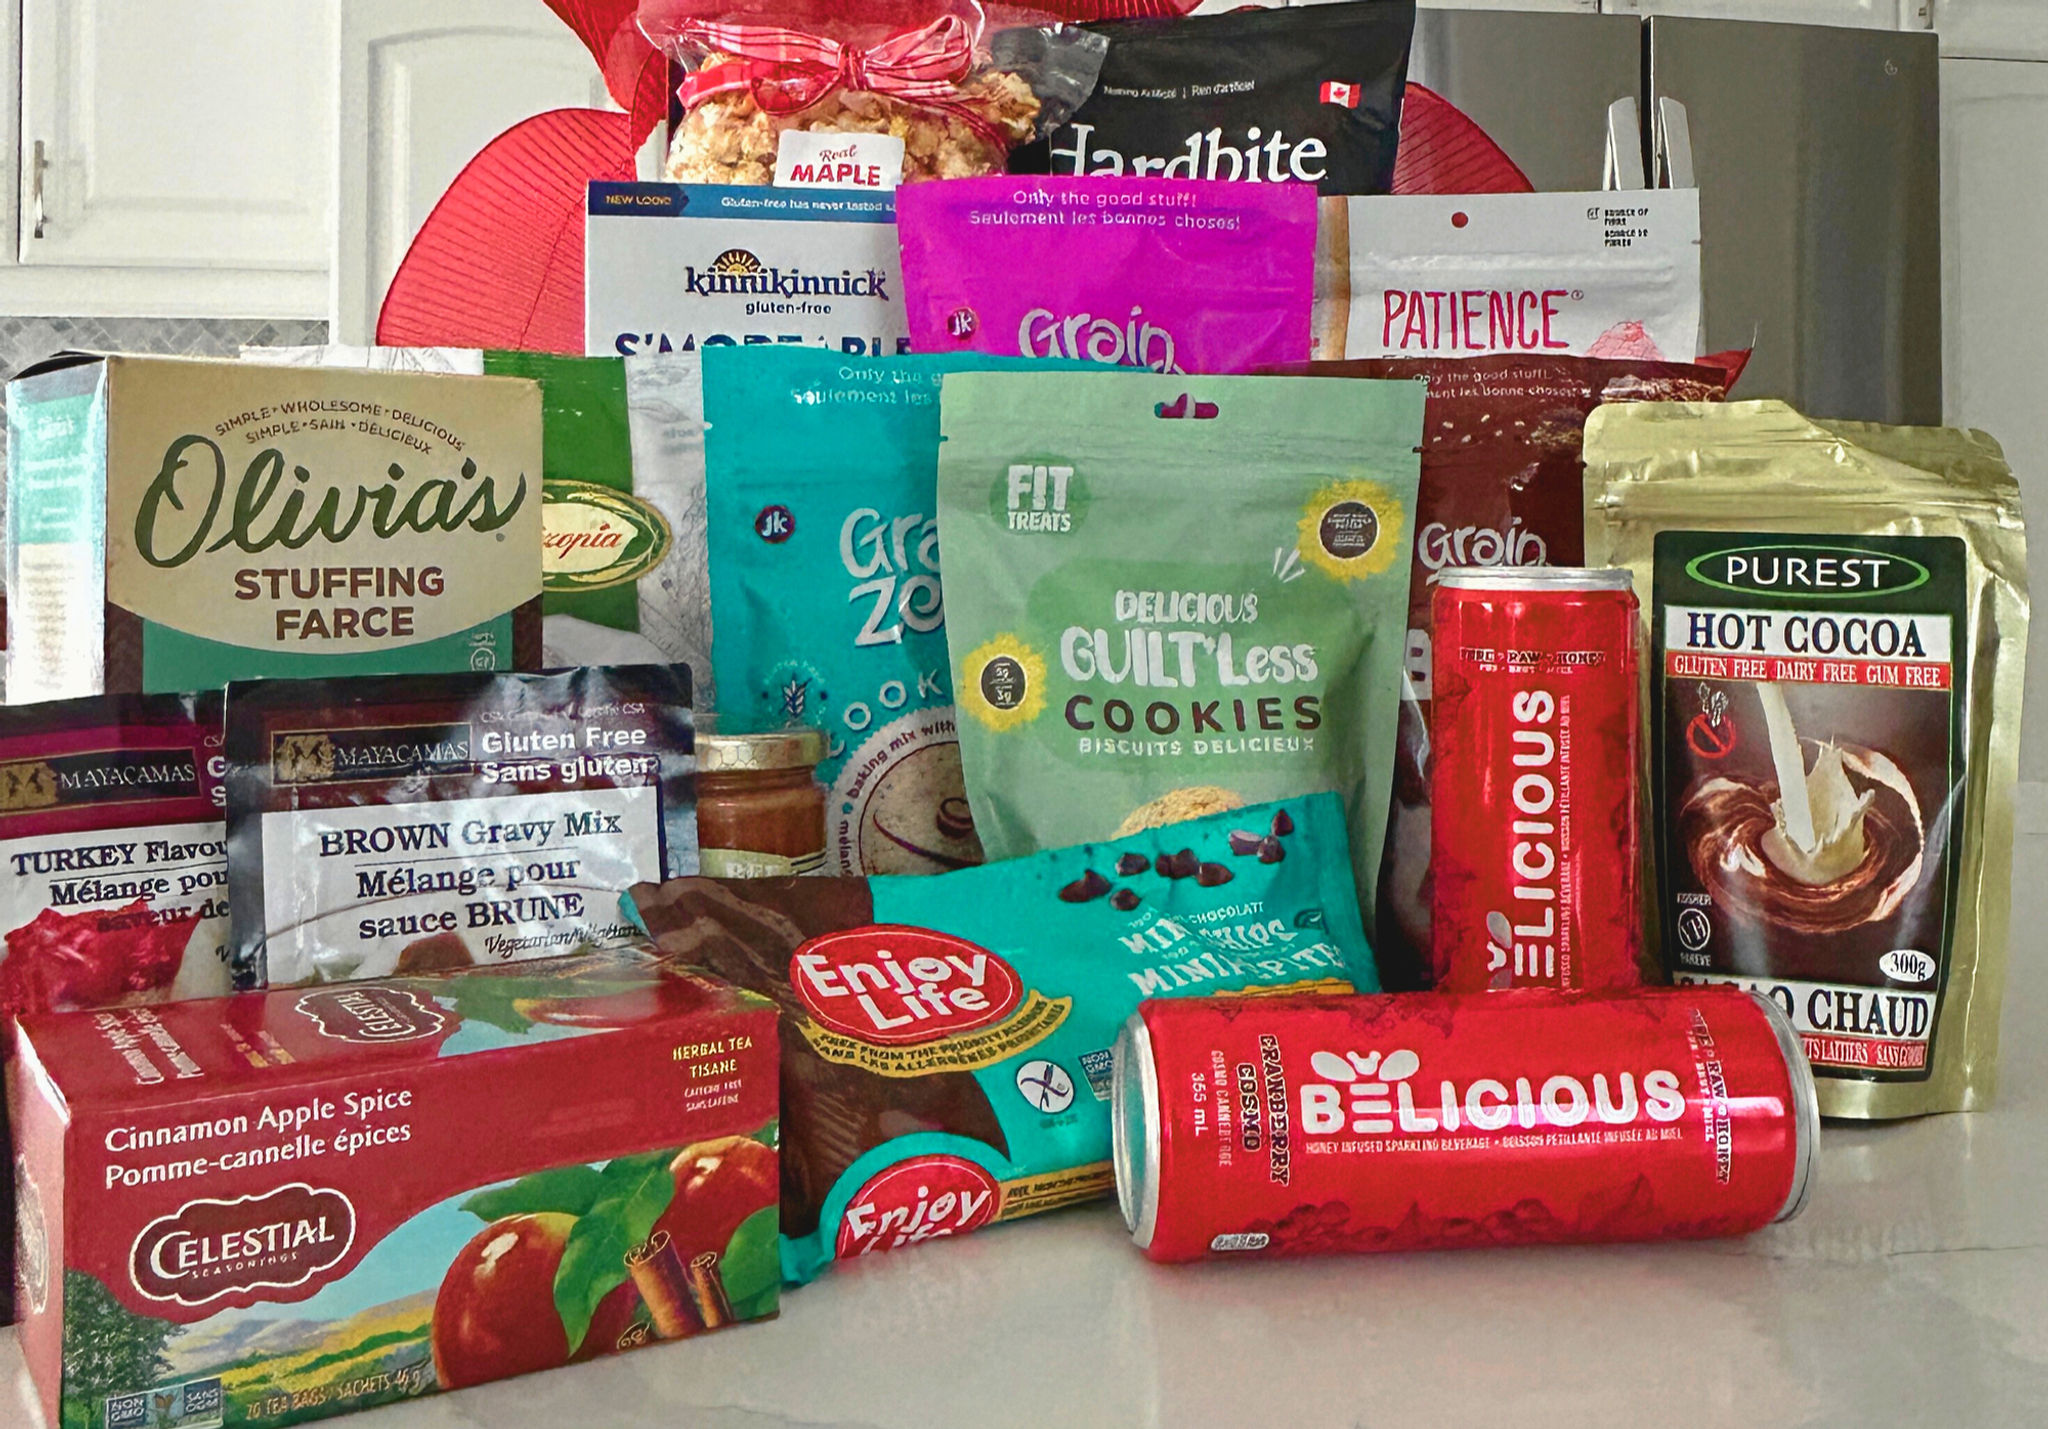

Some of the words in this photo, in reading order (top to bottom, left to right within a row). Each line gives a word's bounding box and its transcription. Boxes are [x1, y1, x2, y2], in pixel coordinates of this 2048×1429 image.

[820, 145, 858, 162] Real
[790, 164, 881, 186] MAPLE
[606, 195, 635, 205] NEW
[1013, 190, 1054, 207] Only
[1061, 191, 1090, 206] the
[1096, 192, 1143, 209] good
[1072, 210, 1096, 225] les
[684, 265, 890, 301] kinnikinnick
[745, 301, 832, 316] gluten-free
[838, 366, 884, 383] Only
[1473, 370, 1508, 382] good
[215, 406, 272, 437] SIMPLE
[281, 400, 382, 417] WHOLESOME
[246, 420, 301, 444] SIMPLE
[134, 433, 527, 568] Olivia's
[1007, 464, 1075, 511] FIT
[1007, 511, 1072, 533] TREATS
[1418, 516, 1548, 570] Grain
[234, 566, 445, 600] STUFFING
[1727, 556, 1890, 588] PUREST
[1115, 588, 1259, 624] DELICIOUS
[276, 607, 414, 641] FARCE
[1686, 612, 1772, 651] HOT
[1784, 616, 1927, 658] COCOA
[1675, 655, 1728, 677] GLUTEN
[1733, 658, 1767, 680] FREE
[1776, 659, 1818, 682] DAIRY
[1823, 662, 1857, 684] FREE
[1866, 666, 1899, 686] GUM
[1905, 667, 1941, 687] FREE
[1064, 694, 1322, 736] COOKIES
[337, 740, 470, 767] MAYACAMAS
[481, 731, 576, 754] Gluten
[585, 727, 647, 748] Free
[1079, 737, 1183, 756] BISCUITS
[60, 763, 196, 790] MAYACAMAS
[480, 761, 552, 783] Sans
[560, 755, 648, 784] gluten
[846, 749, 889, 800] baking
[889, 731, 917, 752] mix
[319, 823, 450, 858] BROWN
[461, 819, 556, 847] Gravy
[563, 809, 623, 838] Mix
[10, 843, 138, 877] TURKEY
[50, 876, 170, 907] Mélange
[355, 866, 496, 899] Mélange
[506, 860, 582, 892] pour
[359, 911, 458, 941] sauce
[466, 894, 585, 930] BRUNE
[796, 950, 987, 998] Enjoy
[1890, 952, 1927, 980] 300g
[858, 983, 990, 1030] Life
[1807, 989, 1930, 1038] CHAUD
[672, 1041, 725, 1061] HERBAL
[728, 1035, 753, 1052] TEA
[906, 1045, 938, 1059] THE
[689, 1058, 738, 1078] TISANE
[1707, 1059, 1729, 1100] RAW
[1191, 1072, 1207, 1103] 355
[105, 1114, 248, 1153] Cinnamon
[257, 1098, 335, 1134] Apple
[344, 1088, 412, 1119] Spice
[1194, 1109, 1209, 1137] mL
[1236, 1062, 1261, 1152] COSMO
[1259, 1033, 1290, 1187] CRANBERRY
[105, 1134, 327, 1190] Pomme-cannelle
[333, 1123, 412, 1156] épices
[847, 1186, 993, 1241] Enjoy
[150, 1216, 335, 1280] CELESTIAL
[191, 1251, 298, 1280] SEASONINGS
